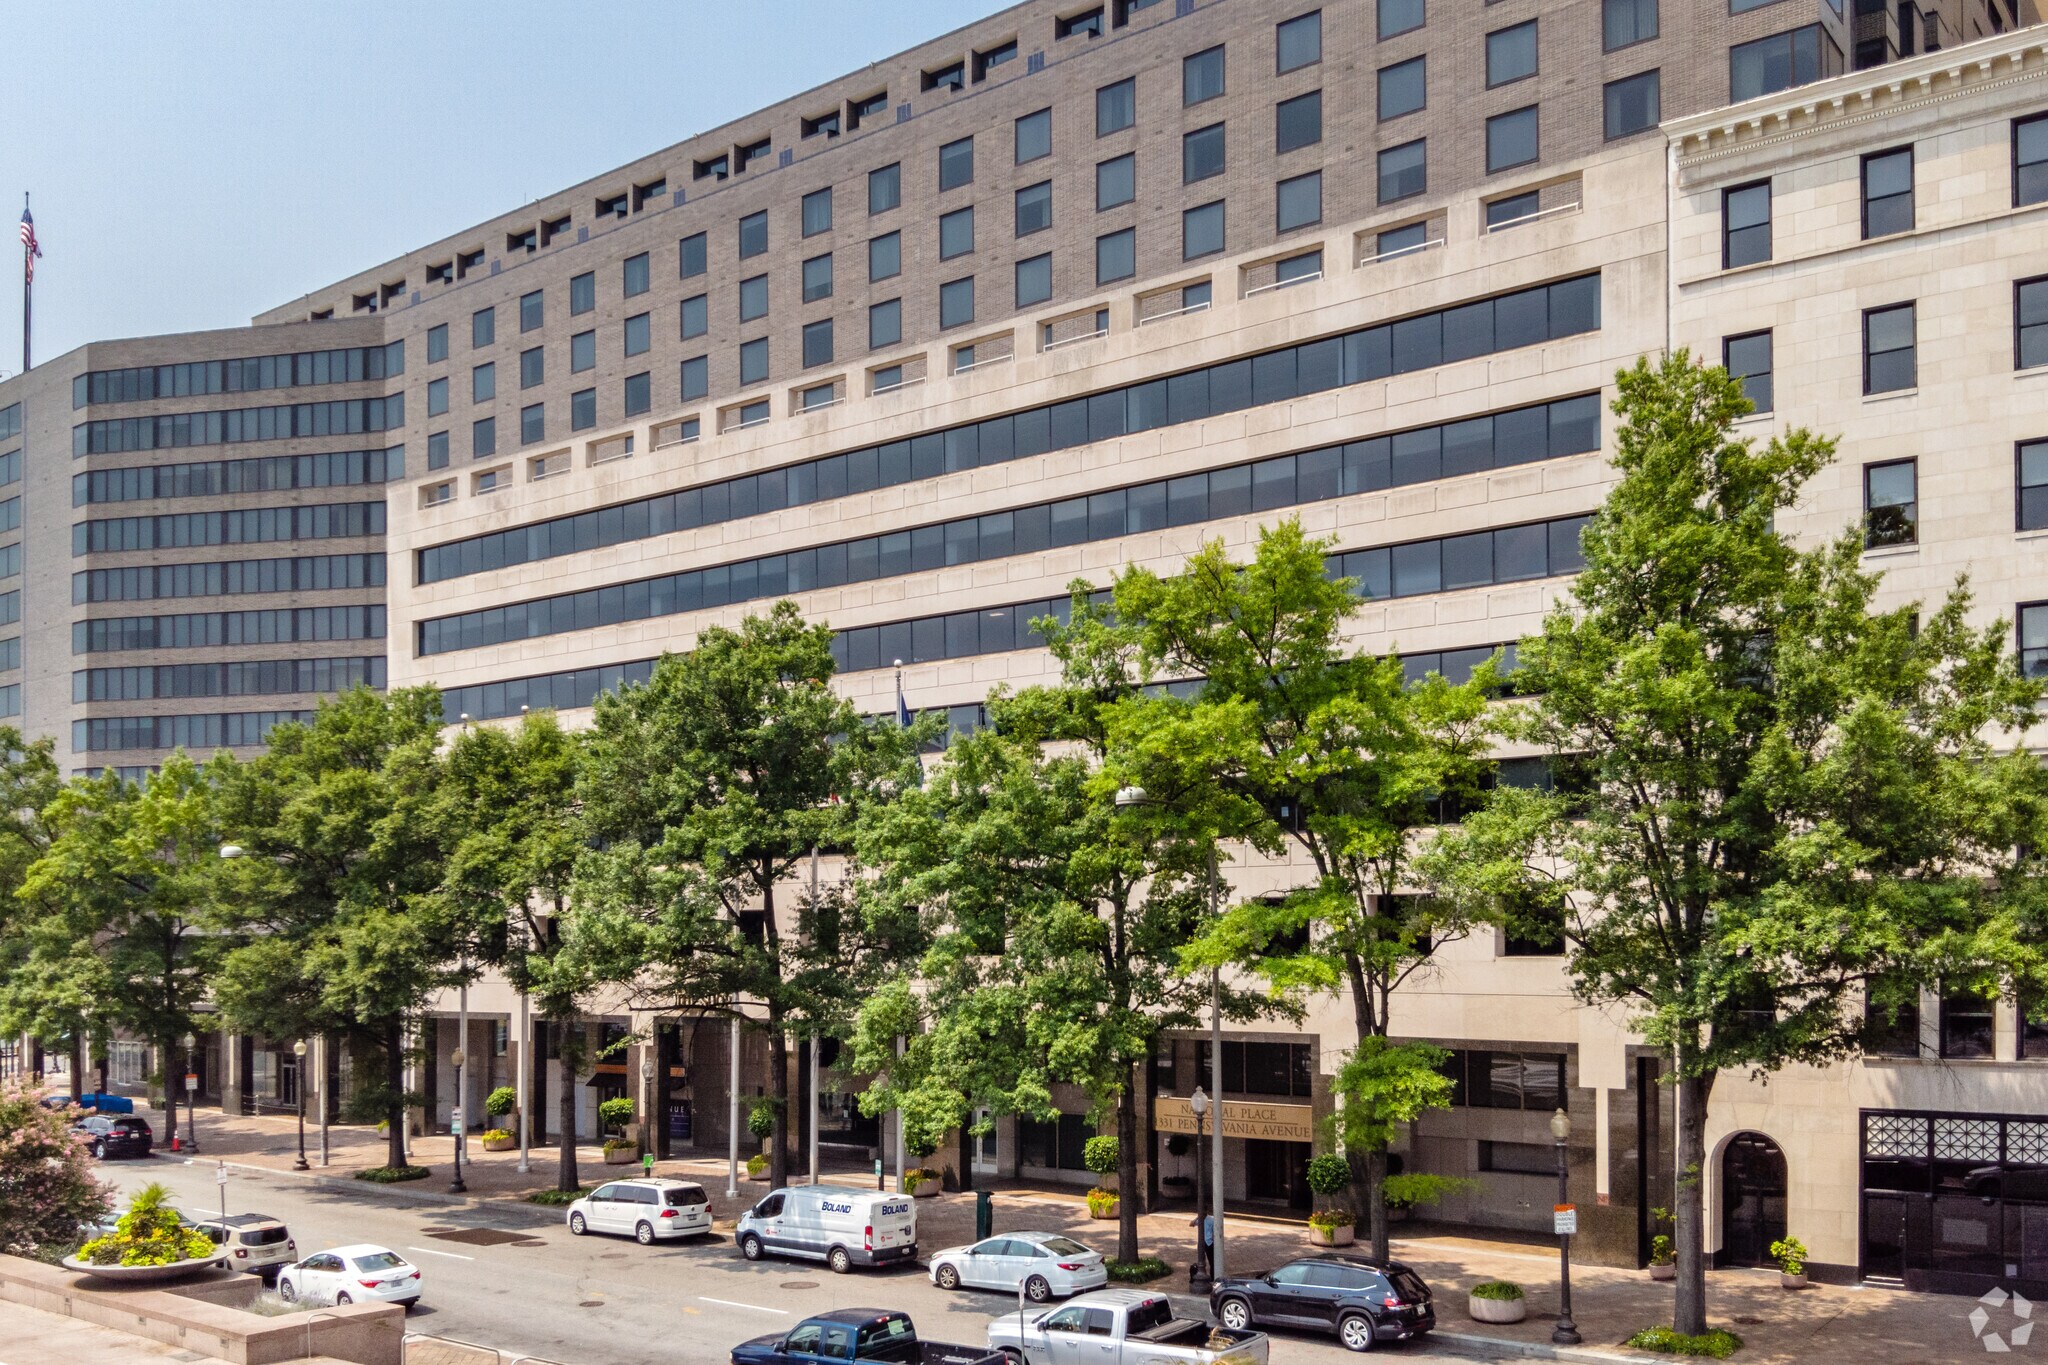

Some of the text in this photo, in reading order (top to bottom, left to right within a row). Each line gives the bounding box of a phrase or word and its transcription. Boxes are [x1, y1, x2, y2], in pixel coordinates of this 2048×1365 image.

[1181, 1104, 1277, 1120] NAOAL PLACE
[1262, 1124, 1311, 1138] AVENUE
[821, 1201, 852, 1213] BOLAND
[881, 1203, 909, 1216] BOLAND
